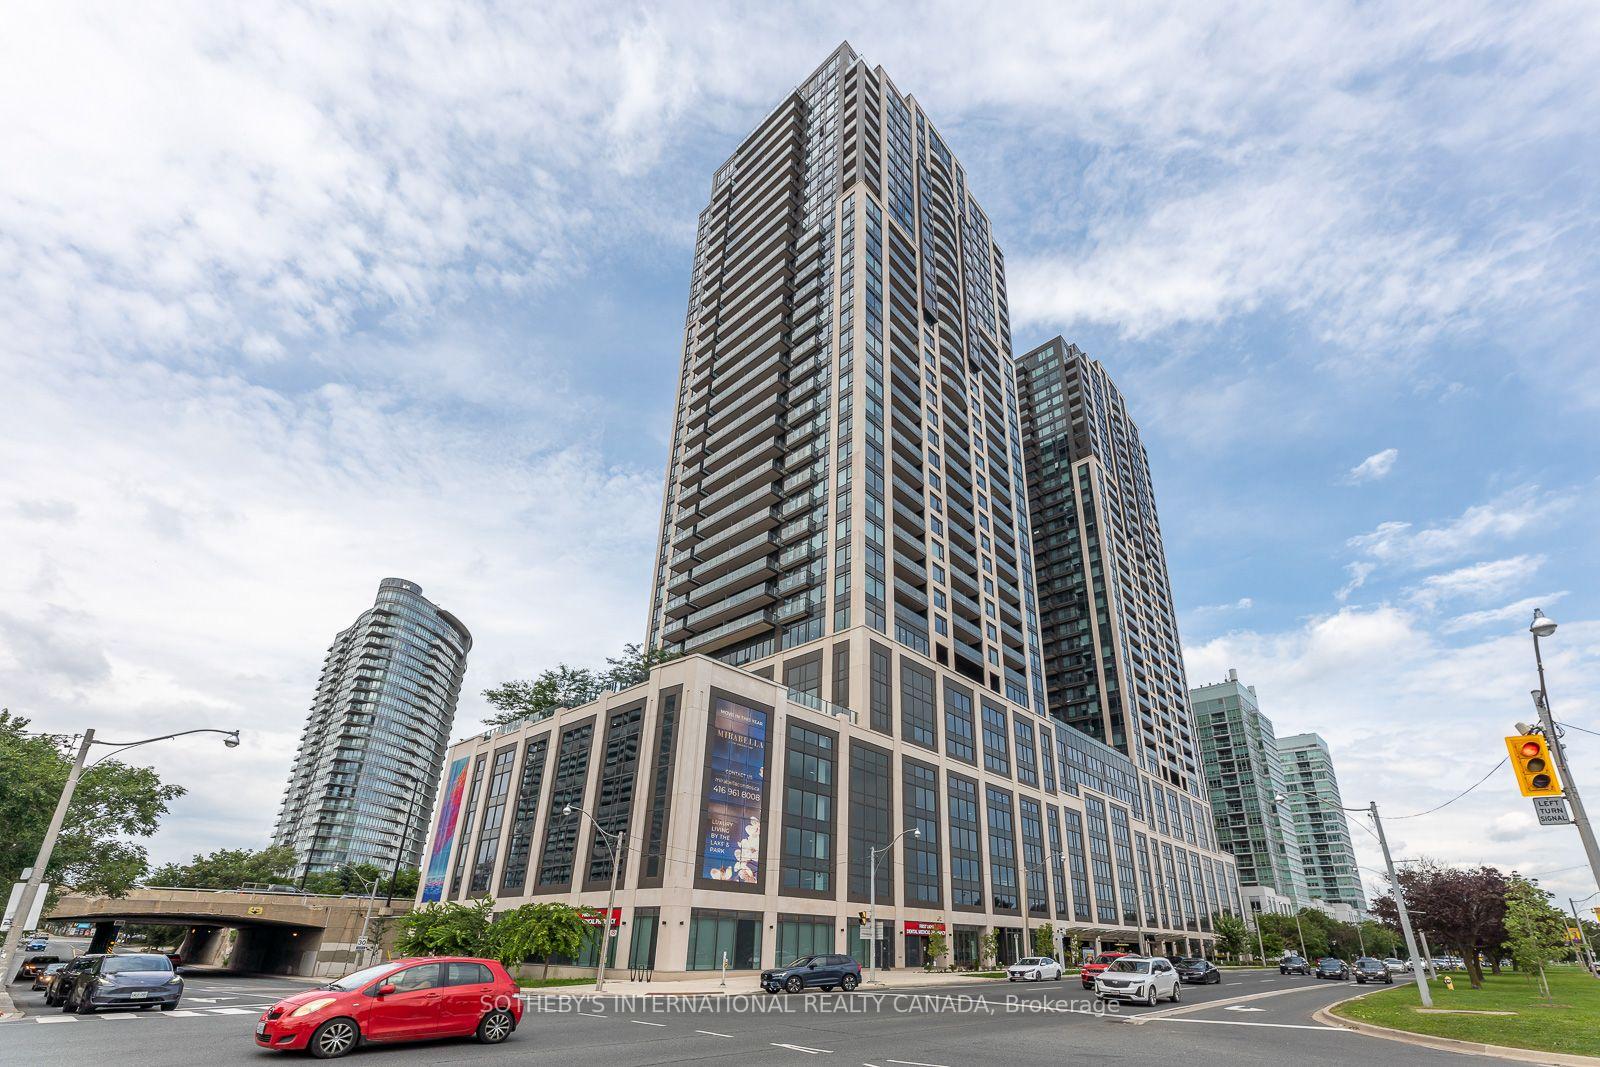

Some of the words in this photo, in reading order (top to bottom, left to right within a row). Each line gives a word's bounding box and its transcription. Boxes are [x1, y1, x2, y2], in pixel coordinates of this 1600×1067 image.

[718, 730, 764, 748] MIRABELLA
[726, 770, 746, 778] CONTACT
[728, 788, 740, 796] 961
[742, 791, 760, 802] 8008
